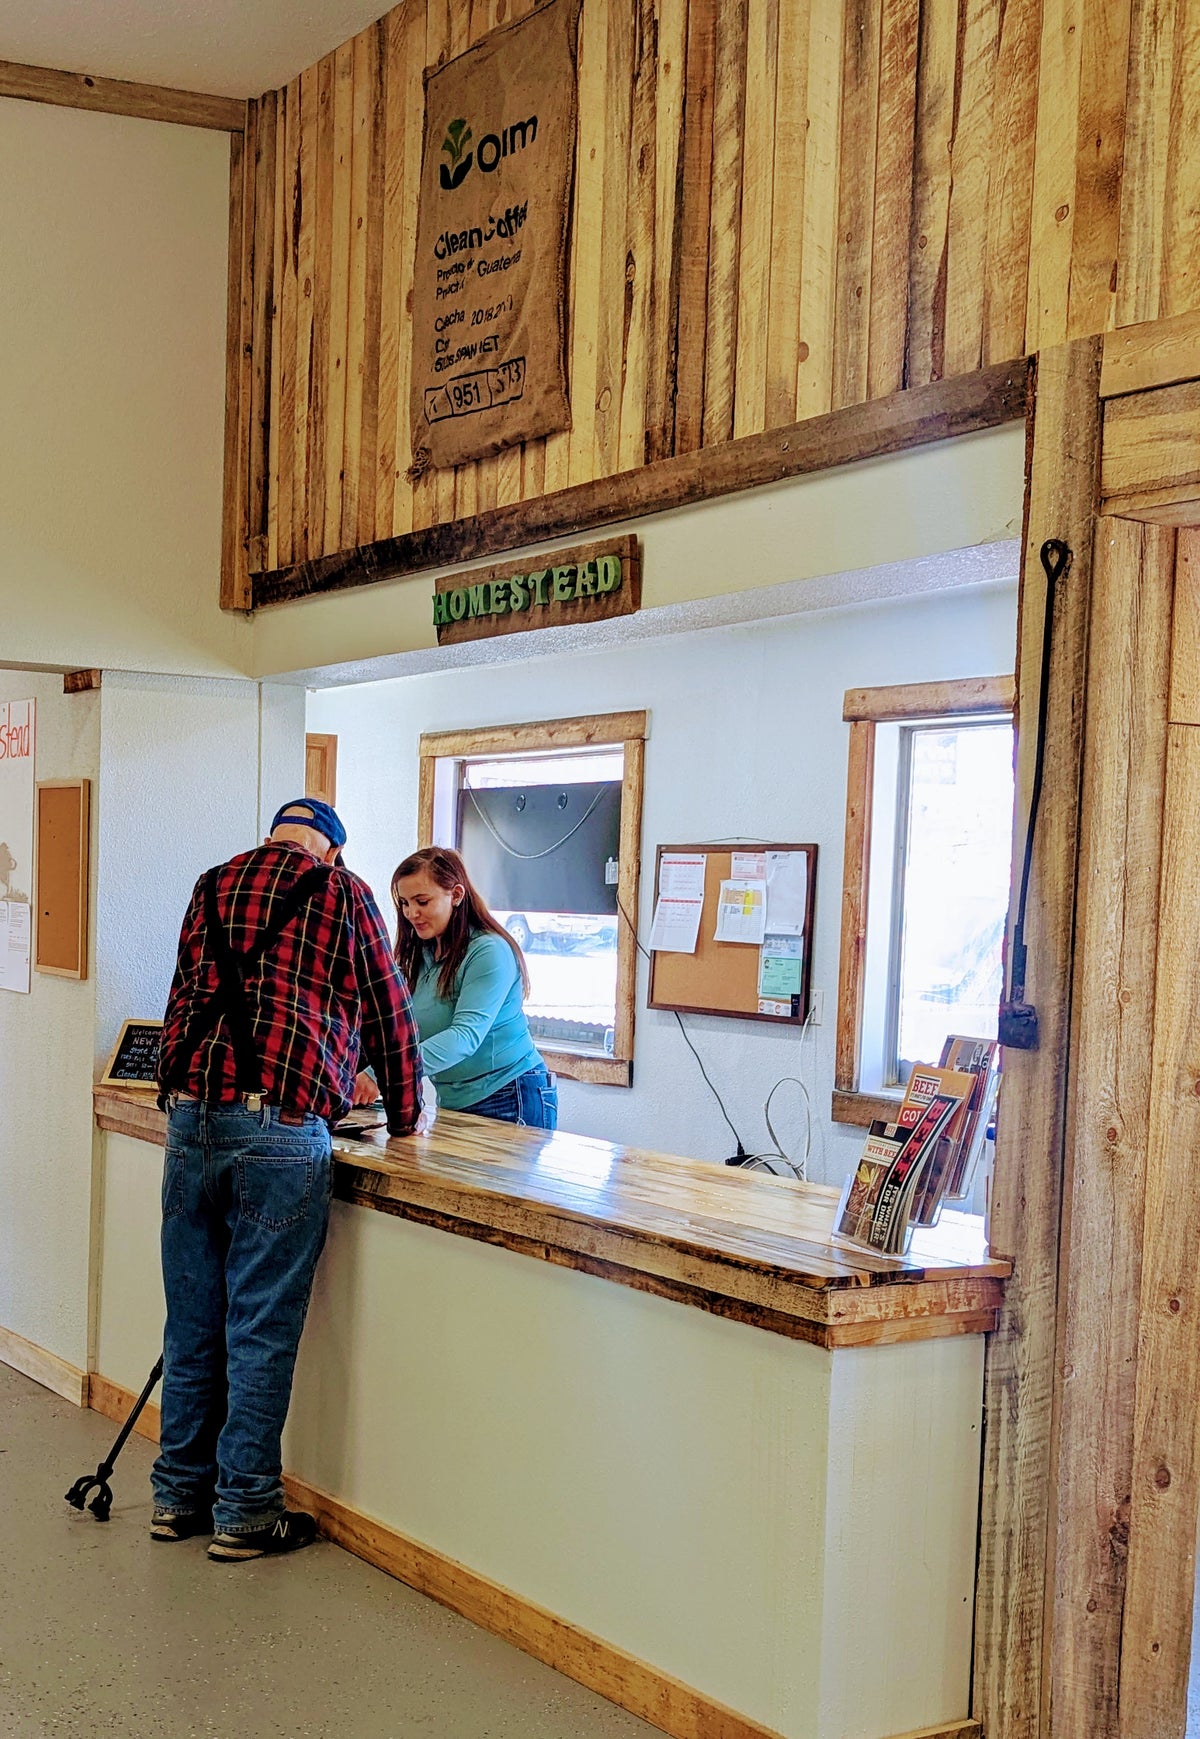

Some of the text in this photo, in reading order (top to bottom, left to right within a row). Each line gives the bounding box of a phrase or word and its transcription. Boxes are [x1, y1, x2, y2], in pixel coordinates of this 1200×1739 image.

[434, 231, 482, 260] Clean
[452, 381, 481, 408] 951
[432, 555, 622, 626] HOMESTEAD
[133, 1036, 154, 1046] NEW
[912, 1079, 939, 1096] BEEF
[882, 1183, 895, 1203] FOR
[272, 1519, 289, 1539] N
